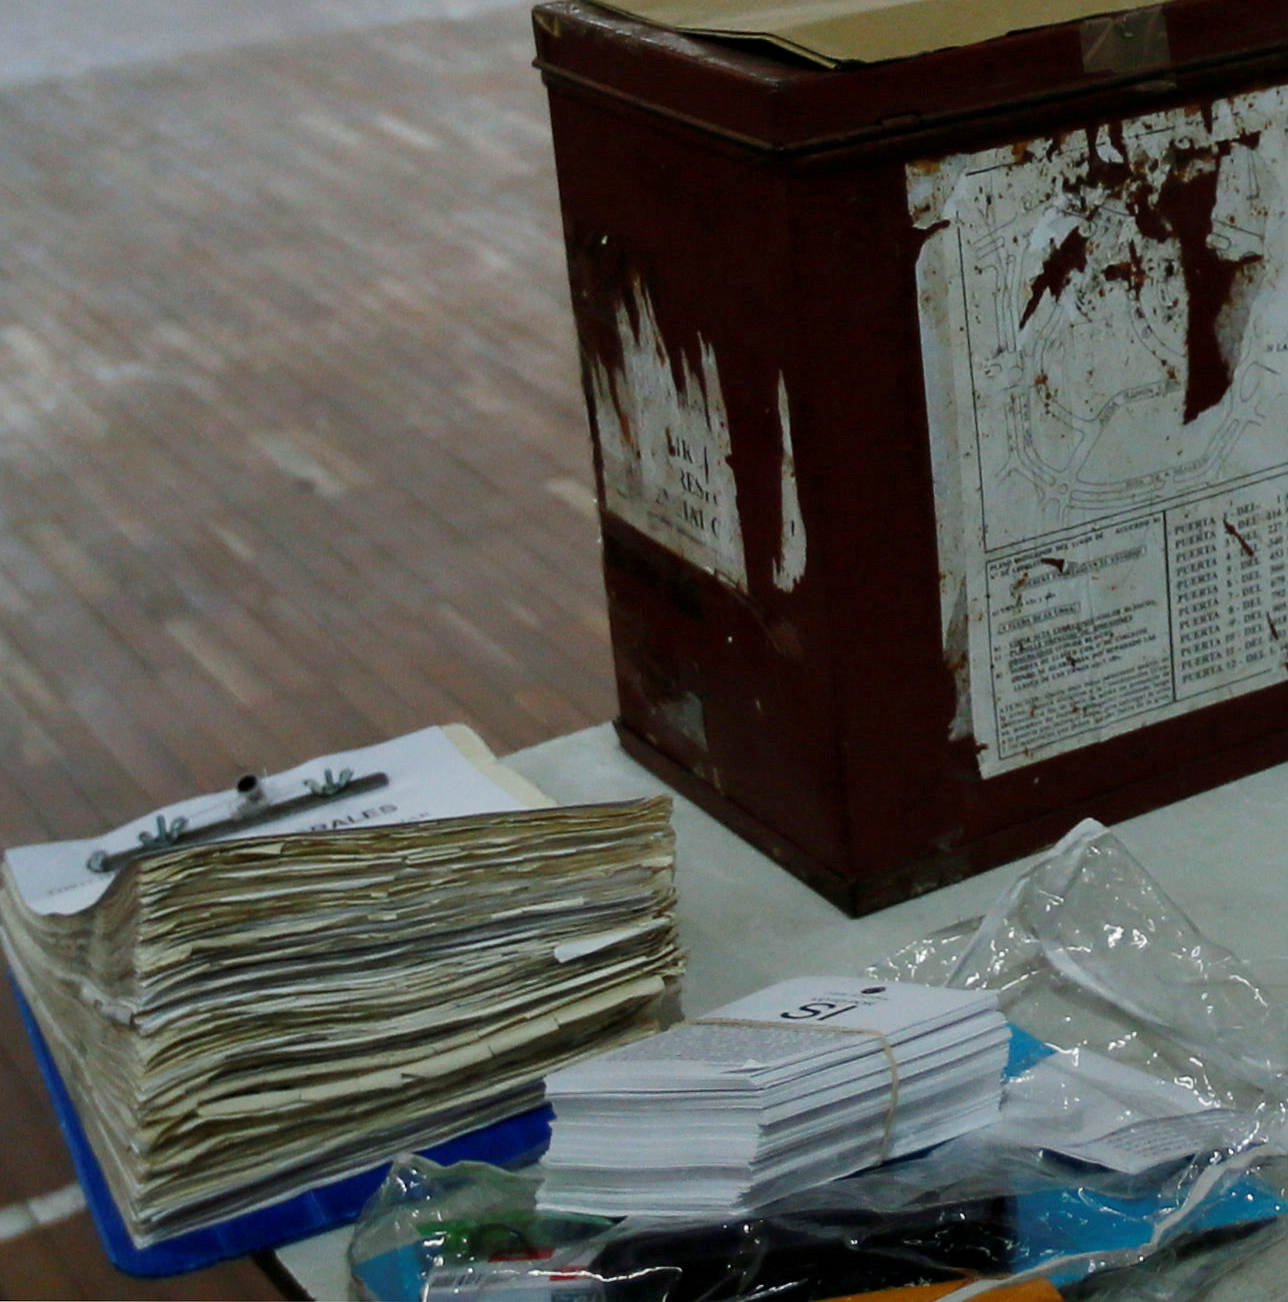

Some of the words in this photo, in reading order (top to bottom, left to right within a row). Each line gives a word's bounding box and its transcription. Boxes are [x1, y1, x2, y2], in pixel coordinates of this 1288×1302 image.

[1174, 516, 1215, 535] PUERTA
[1174, 530, 1216, 549] PUERTA
[1175, 543, 1216, 562] PUERTA
[1176, 558, 1217, 576] PUERTA
[1177, 571, 1218, 590] PUERTA
[1177, 585, 1218, 603] PUERTA
[1178, 598, 1219, 616] PUERTA
[1179, 611, 1219, 629] PUERTA
[1179, 625, 1220, 643] PUERTA
[1180, 638, 1221, 656] PUERTA
[1181, 651, 1221, 670] PUERTA
[1181, 665, 1222, 683] PUERTA
